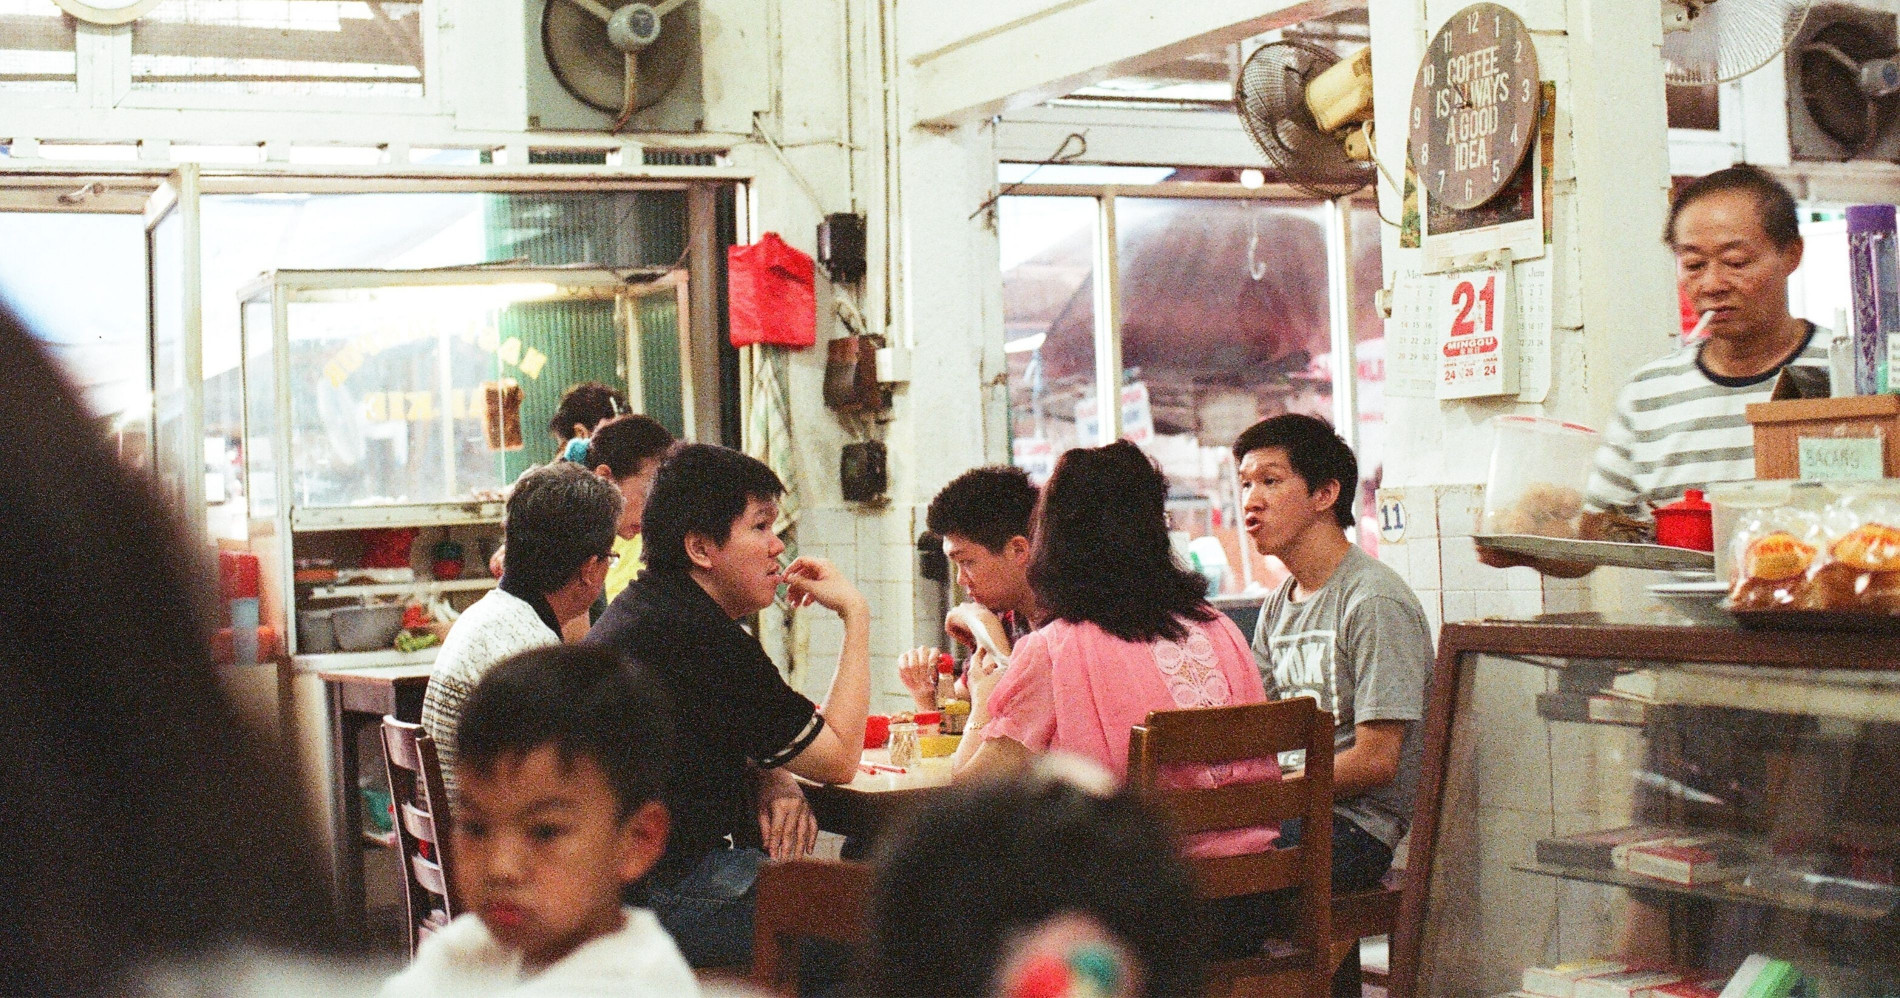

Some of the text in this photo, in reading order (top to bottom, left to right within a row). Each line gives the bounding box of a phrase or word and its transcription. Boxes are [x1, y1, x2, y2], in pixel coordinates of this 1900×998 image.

[1467, 12, 1479, 35] 12
[1494, 16, 1500, 38] 1
[1444, 31, 1452, 53] 11
[1514, 41, 1522, 63] 2
[1423, 64, 1435, 87] 10
[1447, 46, 1499, 86] COFFEE
[1521, 79, 1530, 102] 3
[1436, 88, 1450, 118] IS
[1413, 107, 1421, 129] 9
[1446, 105, 1498, 145] A GOOD
[1510, 124, 1518, 147] 4
[1421, 143, 1429, 165] 8
[1455, 138, 1487, 172] IDEA
[1437, 170, 1445, 193] 7
[1492, 159, 1500, 183] 5
[1465, 179, 1472, 200] 6
[1450, 276, 1495, 337] 21
[1447, 337, 1494, 350] MINGGU
[1445, 370, 1456, 381] 24
[1484, 365, 1496, 376] 24
[1381, 502, 1404, 531] 11
